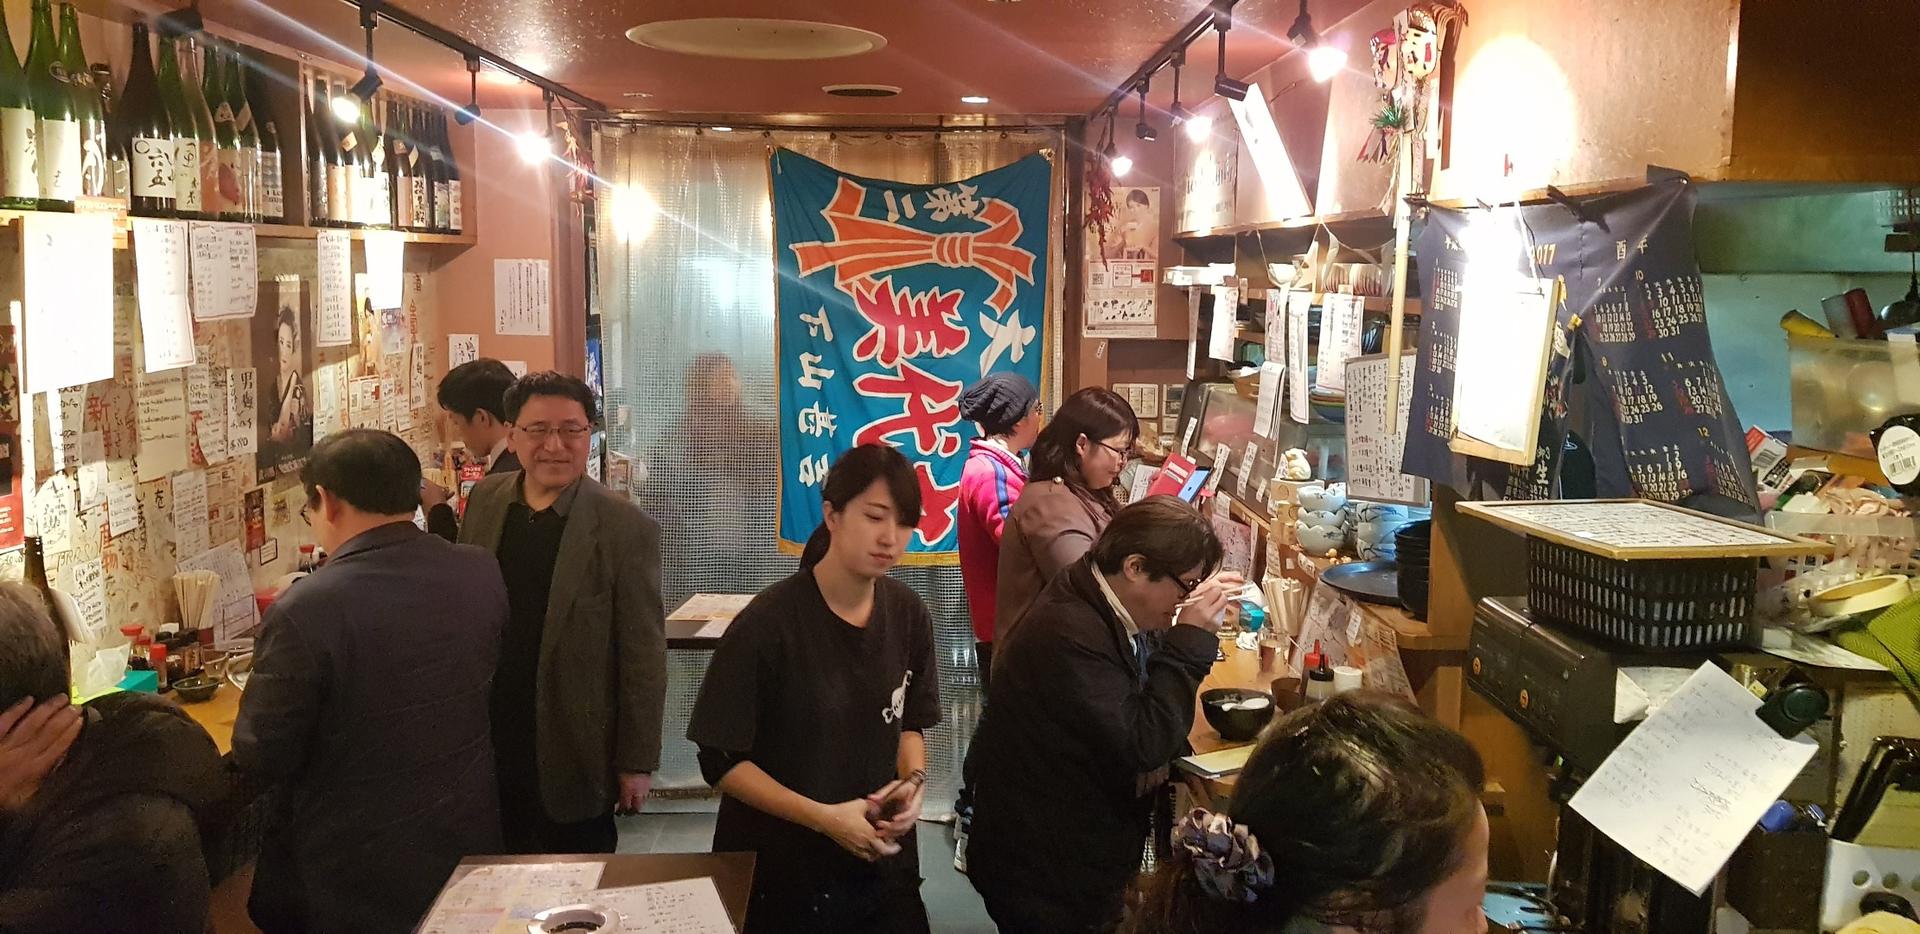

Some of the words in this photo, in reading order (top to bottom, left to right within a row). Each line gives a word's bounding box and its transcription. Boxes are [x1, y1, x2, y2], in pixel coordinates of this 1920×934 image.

[883, 182, 979, 223] 第二
[1635, 270, 1644, 280] 10
[1658, 288, 1663, 298] 3
[1670, 285, 1676, 294] 4
[1680, 284, 1686, 293] 5
[1690, 283, 1694, 292] 6
[1660, 296, 1668, 307] 10
[1672, 294, 1680, 305] 11
[1683, 294, 1690, 303] 12
[1652, 308, 1660, 318] 16
[1663, 306, 1671, 316] 17
[1675, 304, 1684, 314] 18
[1686, 303, 1694, 312] 19
[1654, 319, 1664, 328] 23
[1666, 316, 1676, 326] 24
[1678, 314, 1688, 324] 25
[1658, 328, 1668, 338] 30
[1670, 324, 1680, 336] 31
[1642, 376, 1648, 385] 5
[1685, 378, 1692, 386] 6
[1696, 376, 1700, 386] 7
[1624, 387, 1632, 396] 10
[1645, 384, 1654, 394] 12
[1688, 386, 1697, 396] 13
[798, 303, 838, 490] 下山甚吉
[1628, 396, 1634, 406] 17
[1638, 395, 1646, 404] 18
[1649, 394, 1658, 402] 19
[1690, 395, 1702, 404] 20
[1630, 406, 1640, 414] 24
[1640, 404, 1650, 413] 25
[1652, 402, 1663, 412] 26
[1634, 414, 1644, 424] 31
[1697, 426, 1710, 438] 12
[1674, 451, 1680, 460] 2
[1638, 464, 1642, 474] 5
[1647, 464, 1653, 474] 6
[1656, 464, 1662, 472] 7
[1676, 460, 1682, 470] 9
[1639, 474, 1646, 483] 12
[1648, 473, 1656, 482] 13
[1659, 472, 1666, 482] 14
[1678, 470, 1688, 480] 16
[1650, 482, 1658, 492] 20
[1659, 482, 1666, 492] 21
[1668, 482, 1677, 492] 22
[1670, 491, 1680, 500] 29
